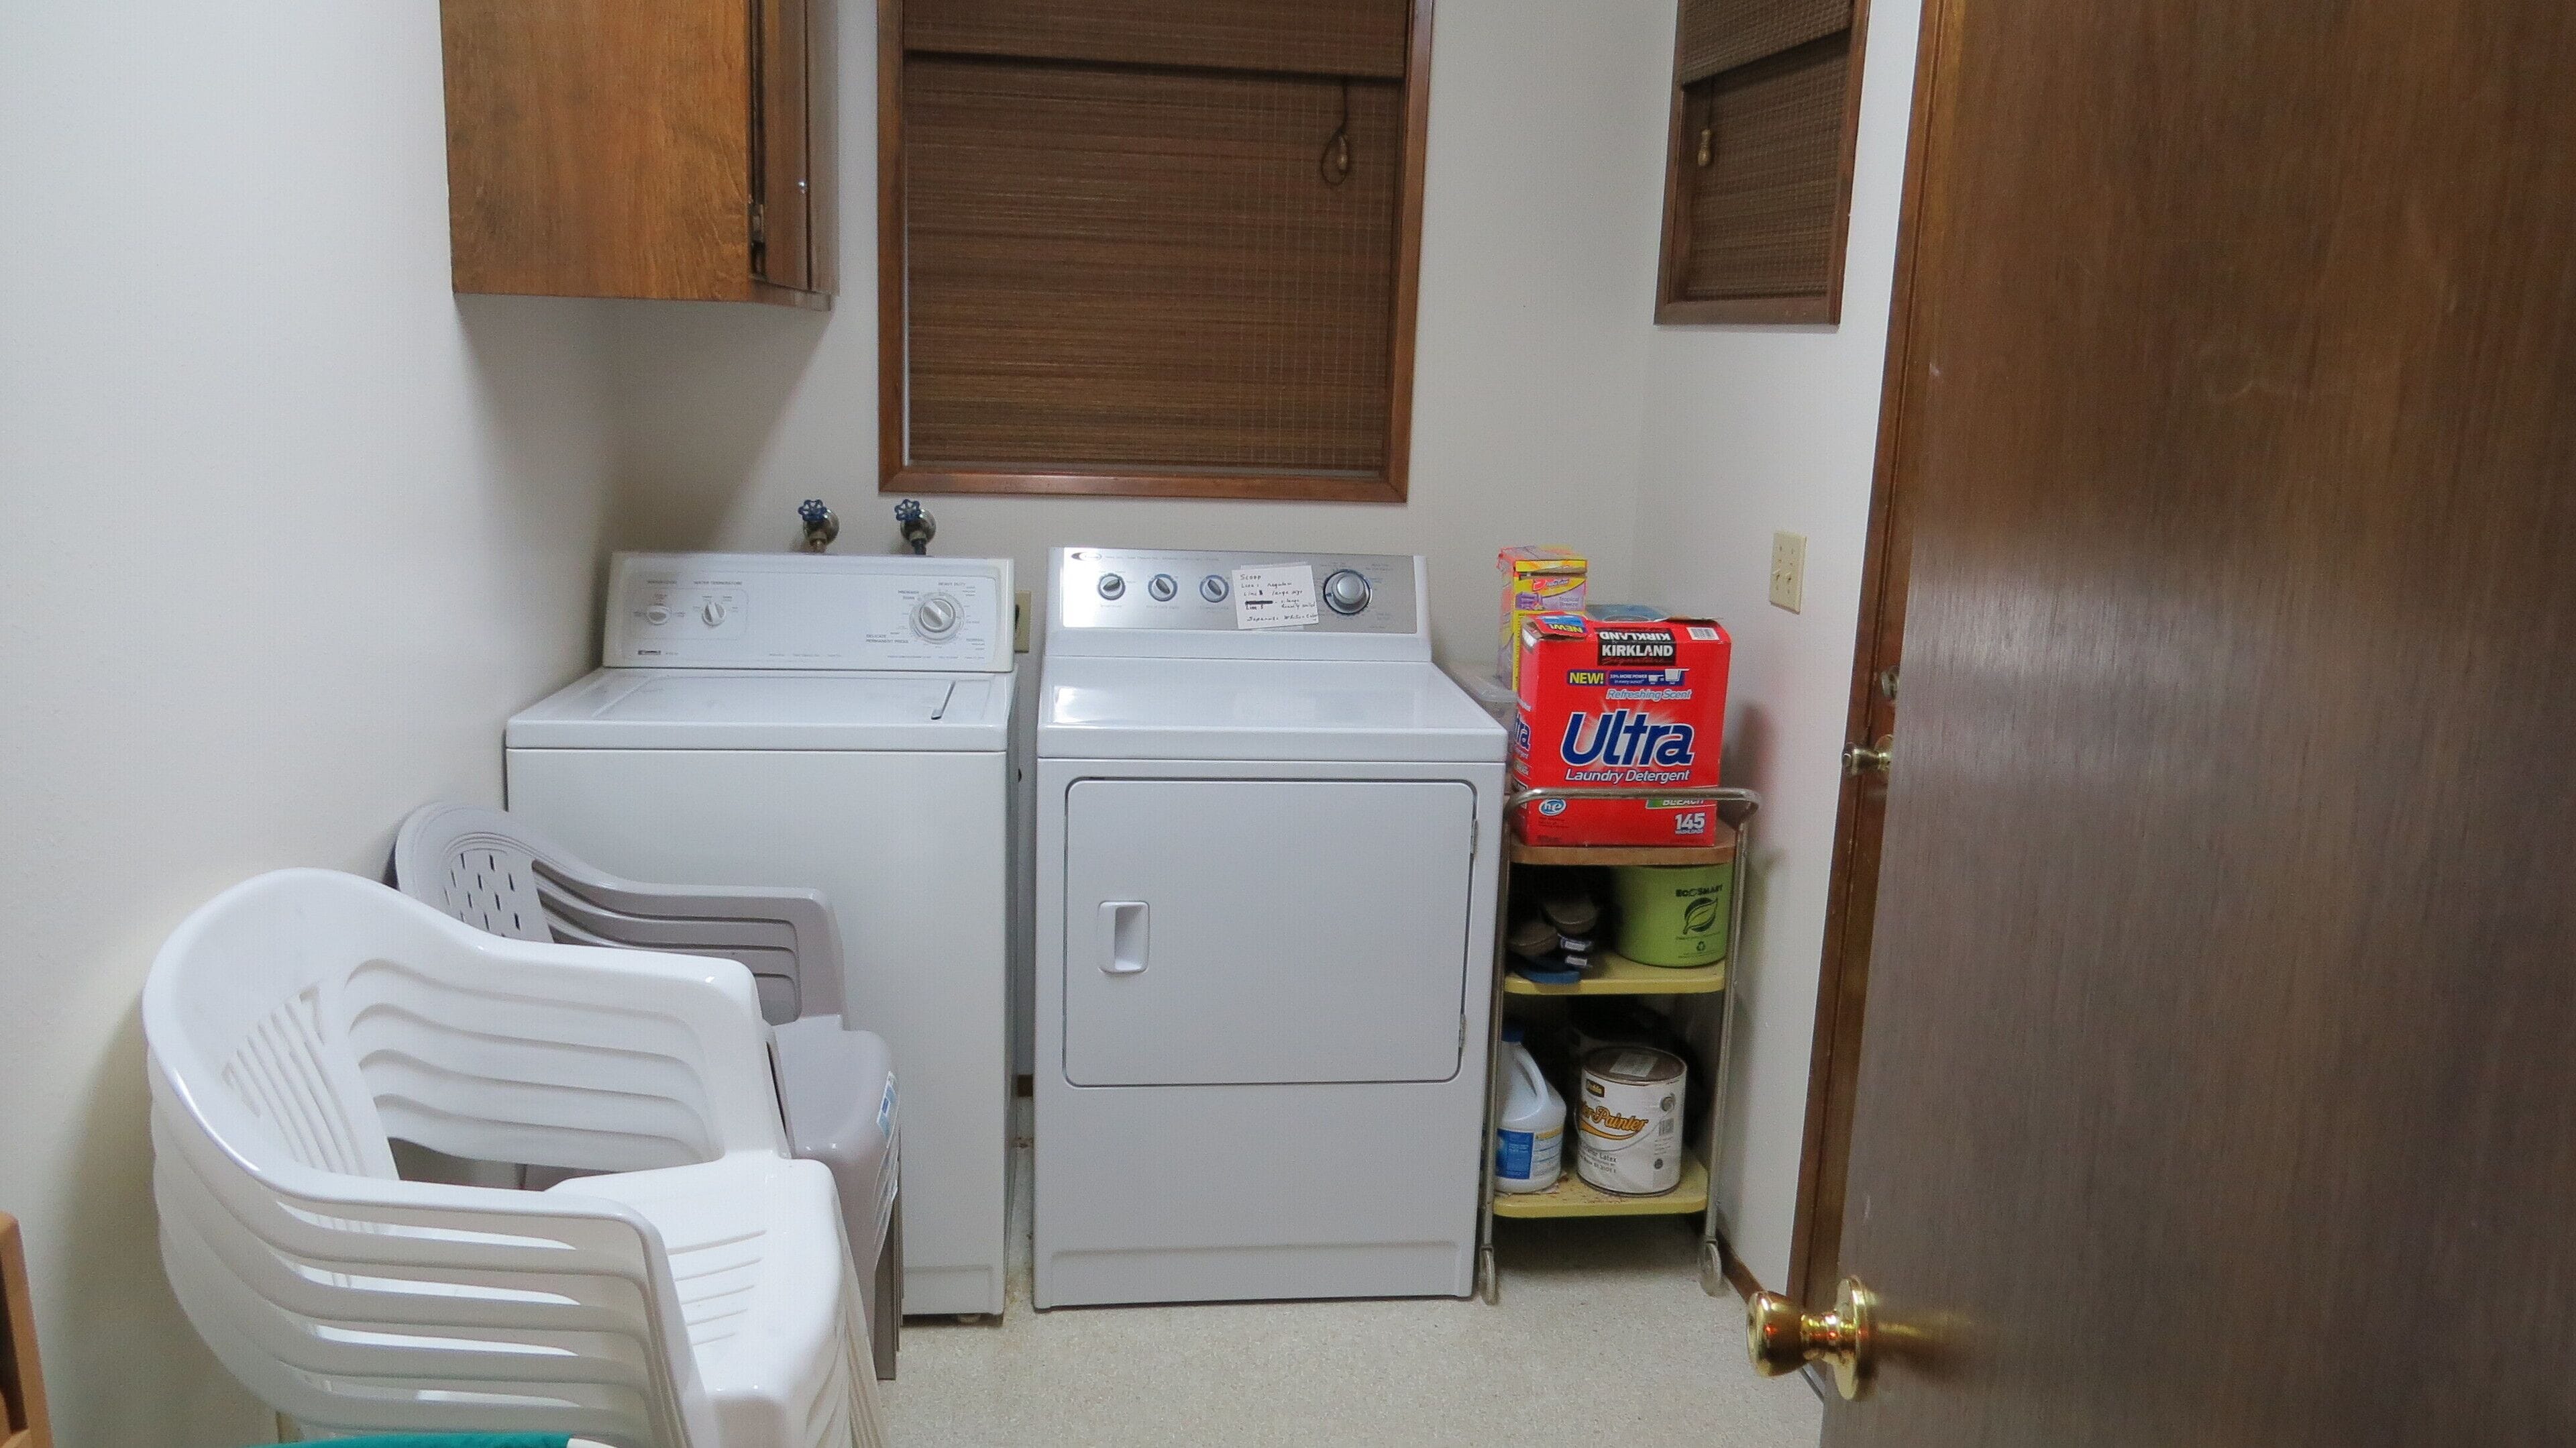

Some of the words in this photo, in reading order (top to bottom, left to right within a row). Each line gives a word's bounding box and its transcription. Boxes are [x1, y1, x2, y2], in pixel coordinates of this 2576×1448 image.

[1599, 631, 1672, 641] KIRKLAND
[1602, 644, 1674, 657] KIRKLAND
[1569, 672, 1604, 684] NEW!
[1605, 688, 1661, 701] Refreshing
[1662, 689, 1693, 700] Scent
[1560, 709, 1695, 767] Ultra
[1565, 768, 1624, 784] Laundry
[1625, 770, 1690, 784] Detergent
[1674, 812, 1705, 830] 145
[1592, 1106, 1649, 1133] Painter
